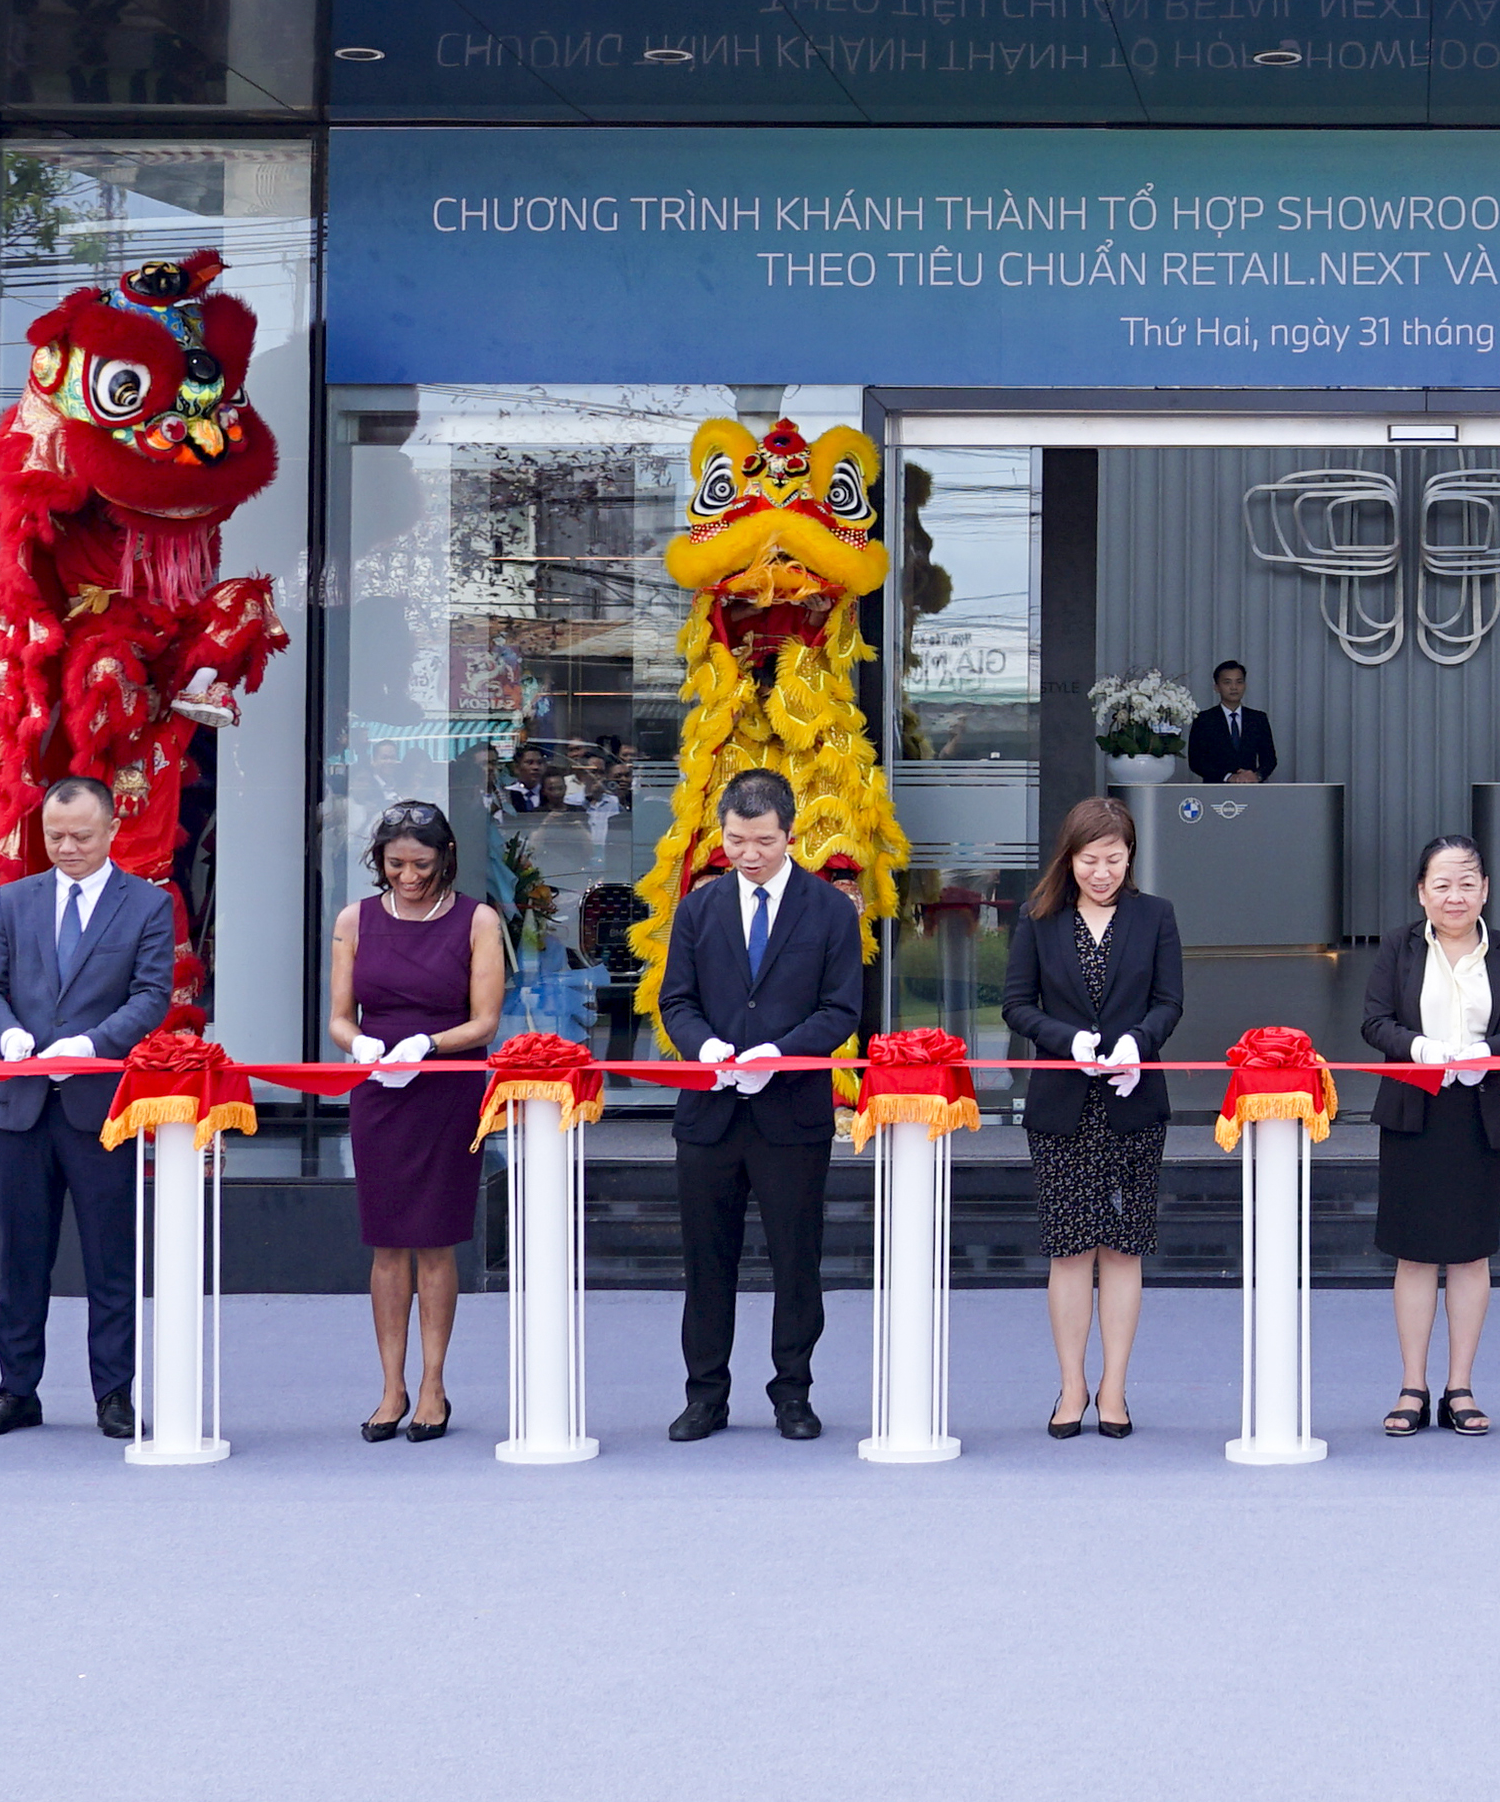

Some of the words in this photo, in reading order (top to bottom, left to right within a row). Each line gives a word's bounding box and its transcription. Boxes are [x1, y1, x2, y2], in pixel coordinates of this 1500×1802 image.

[432, 194, 618, 233] CHƯƠNG
[629, 189, 760, 232] TRÌNH
[776, 188, 923, 231] KHÁNH
[934, 188, 1087, 231] THÀNH
[1097, 182, 1157, 232] TỔ
[1173, 195, 1265, 239] HỢP
[756, 251, 876, 287] THEO
[886, 244, 983, 287] TIÊU
[999, 238, 1146, 287] CHUẨN
[1163, 251, 1431, 286] RETAIL.NEXT
[1443, 243, 1499, 286] VÀ
[1119, 316, 1187, 347] Thứ
[1196, 316, 1259, 352] Hai,
[1271, 316, 1351, 354] ngày
[1358, 316, 1390, 347] 31
[1402, 316, 1494, 353] tháng
